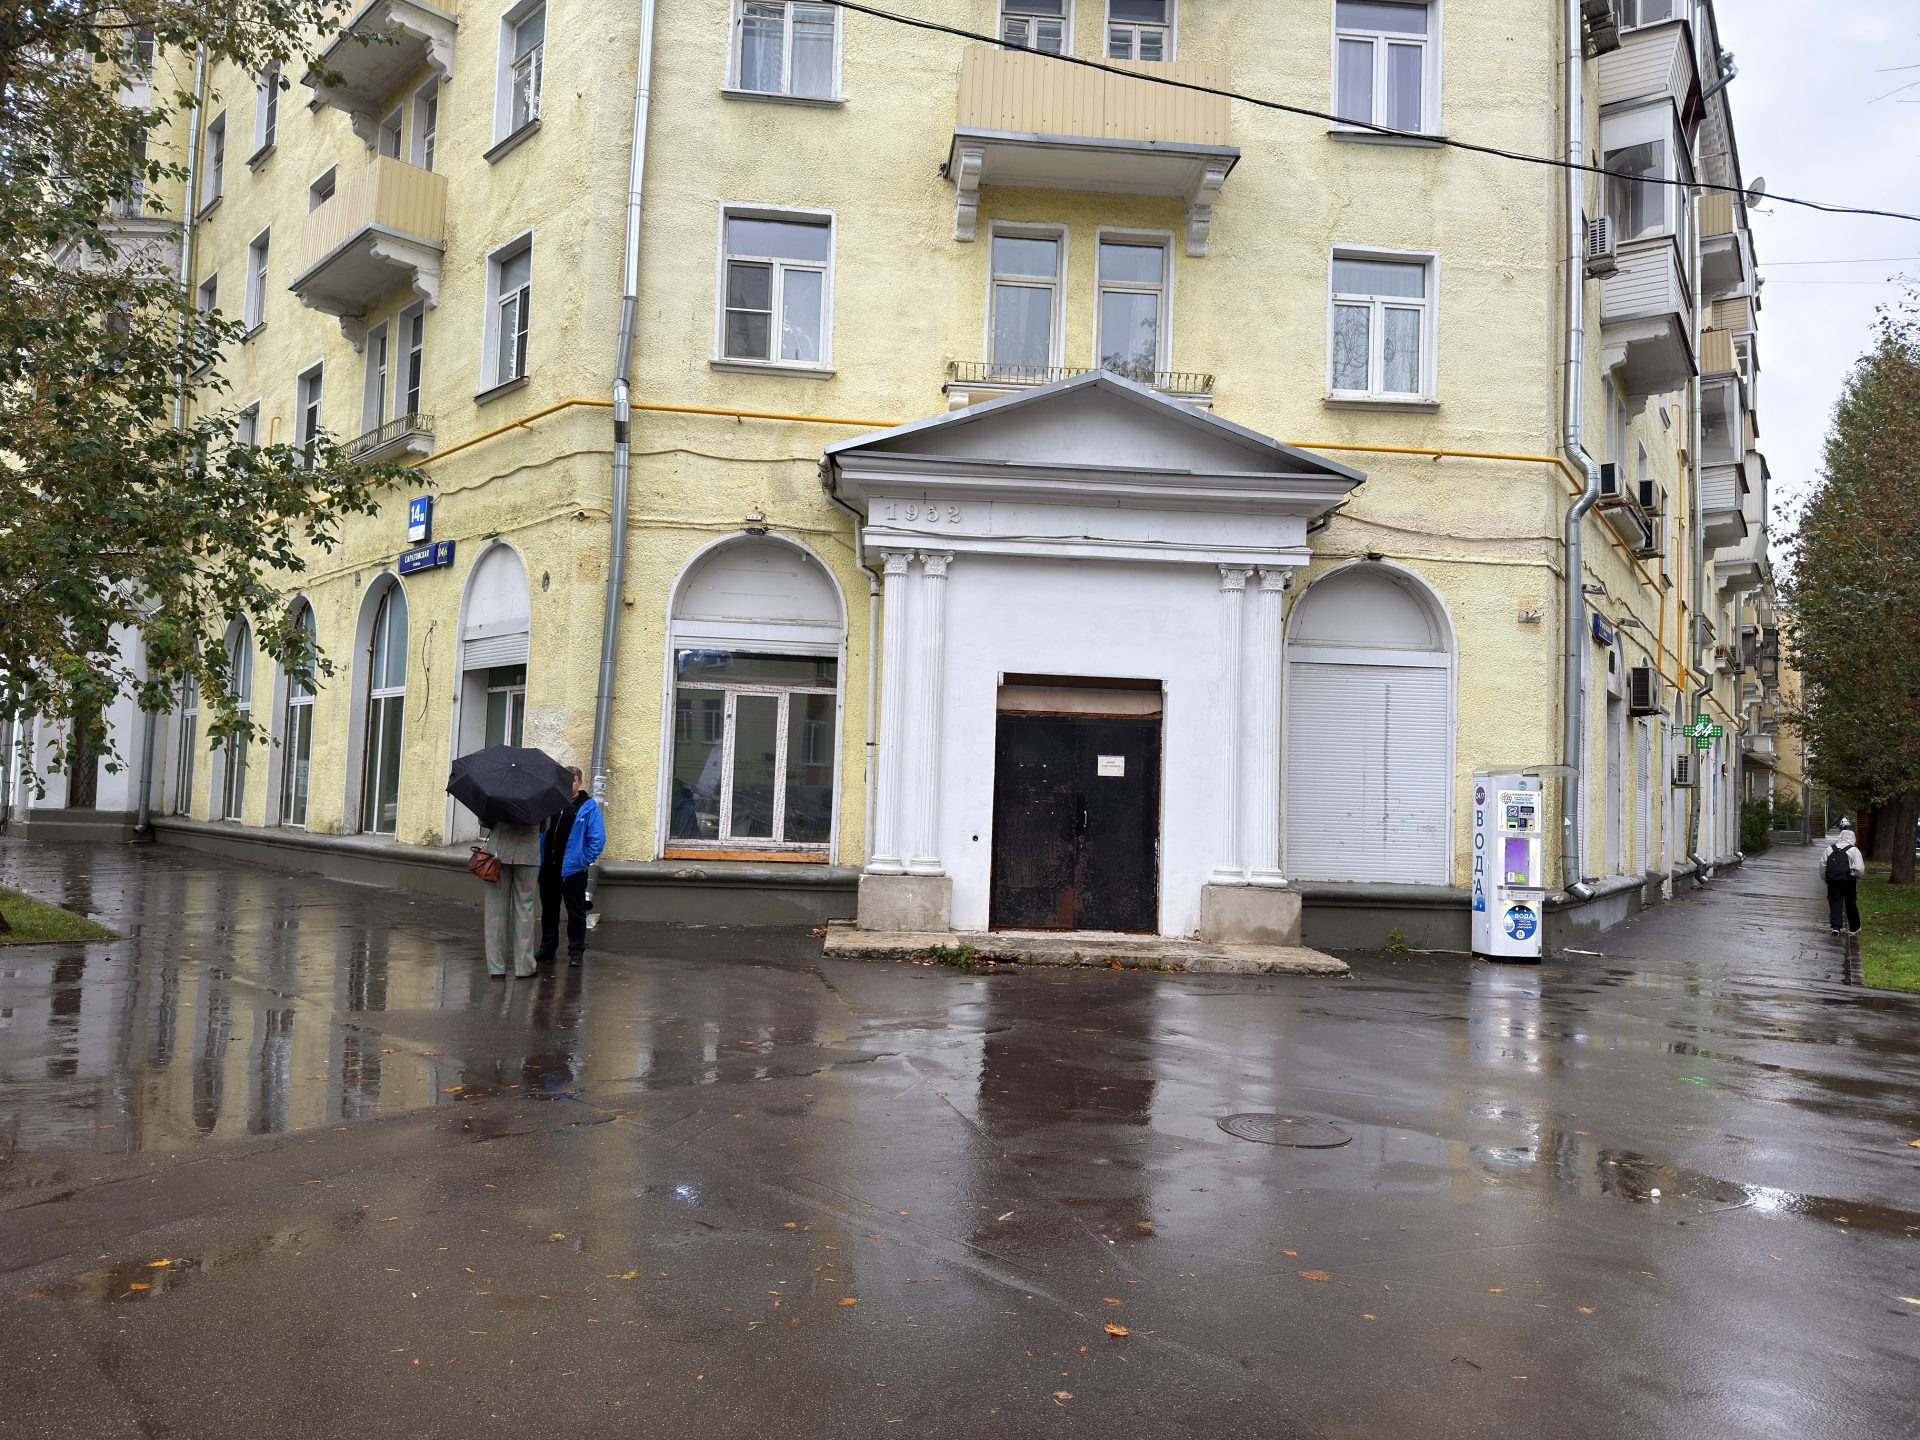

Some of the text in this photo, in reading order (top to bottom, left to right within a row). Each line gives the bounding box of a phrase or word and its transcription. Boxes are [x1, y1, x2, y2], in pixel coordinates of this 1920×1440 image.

[884, 503, 961, 524] 1952
[1691, 723, 1713, 737] 24
[1474, 810, 1484, 895] ВОДА
